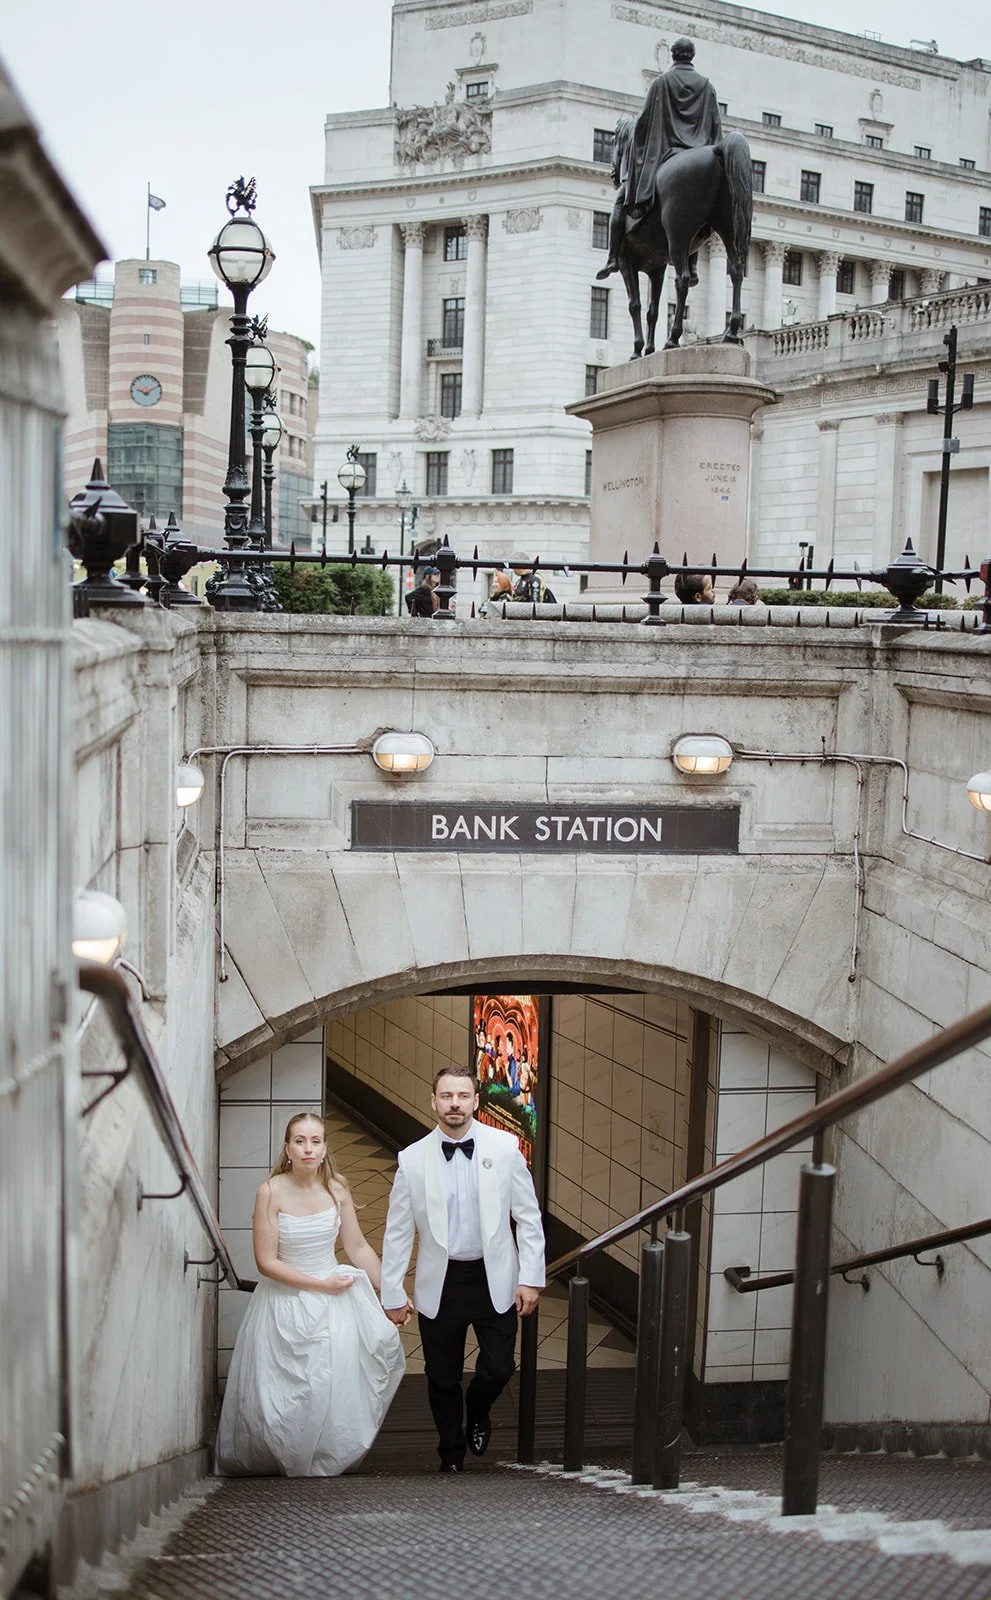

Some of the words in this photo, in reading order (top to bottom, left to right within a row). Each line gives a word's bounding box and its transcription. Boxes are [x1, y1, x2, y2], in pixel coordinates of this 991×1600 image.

[699, 462, 741, 471] ERECTED
[602, 475, 645, 491] WELLINGTON
[704, 474, 729, 483] JUNE
[431, 814, 520, 841] BANK
[534, 815, 663, 842] STATION
